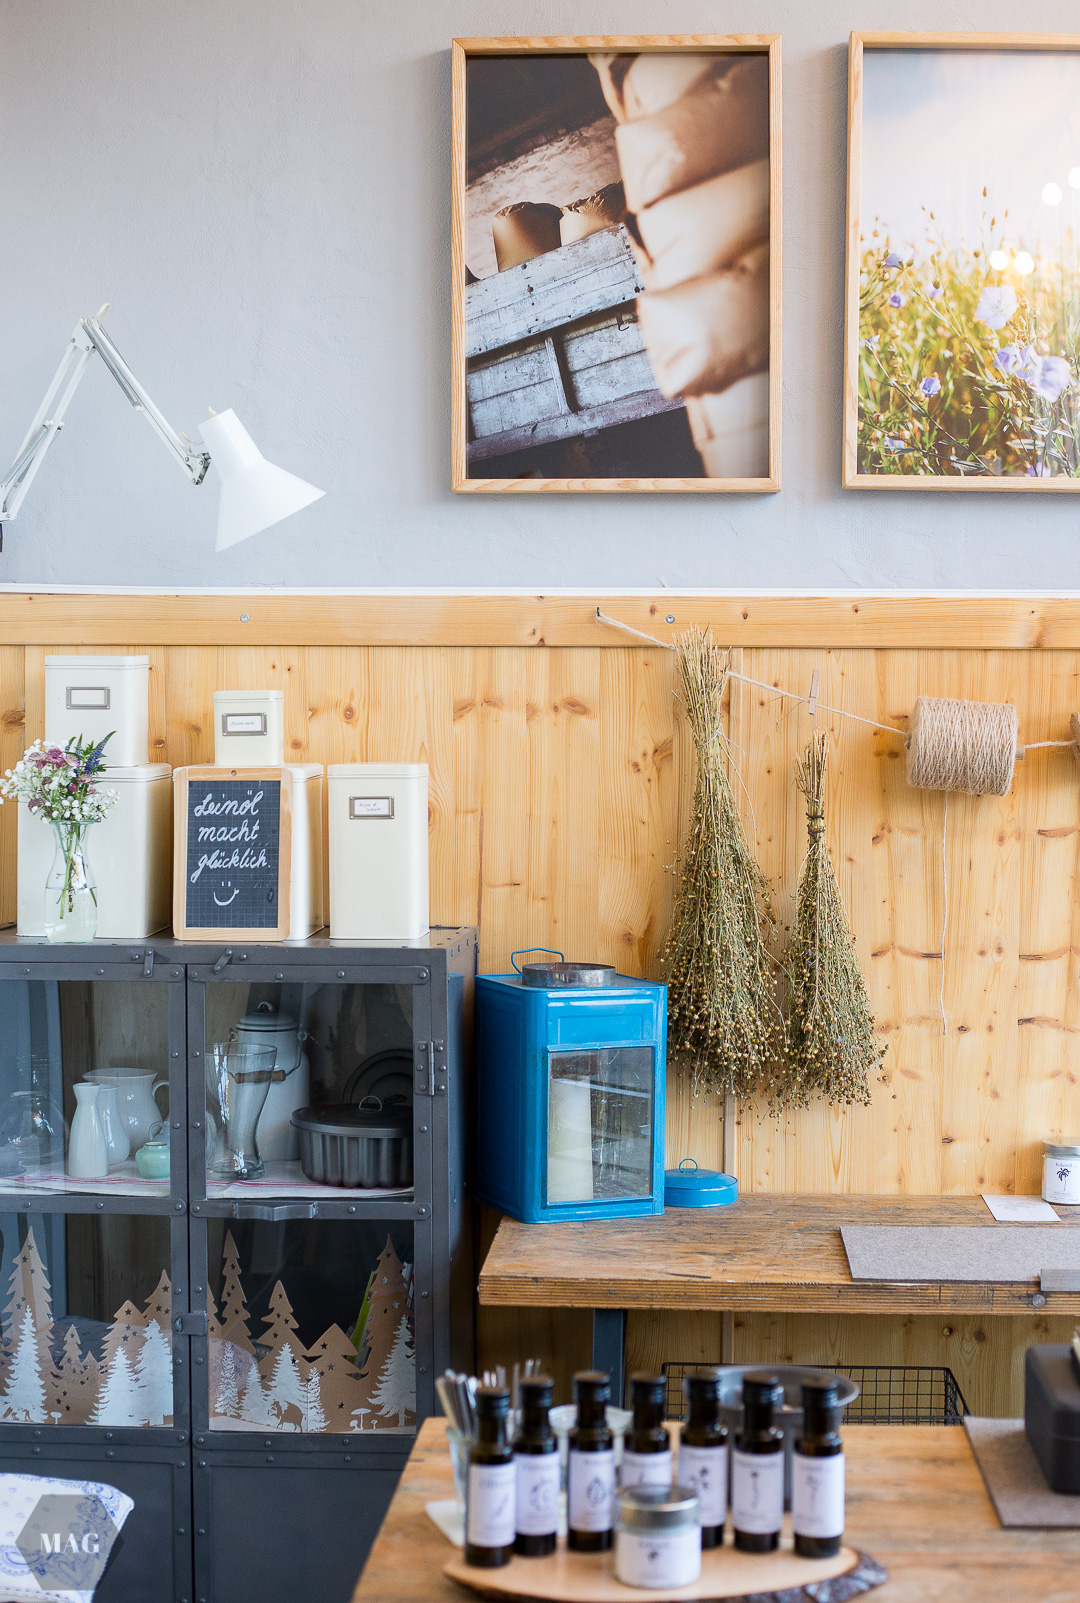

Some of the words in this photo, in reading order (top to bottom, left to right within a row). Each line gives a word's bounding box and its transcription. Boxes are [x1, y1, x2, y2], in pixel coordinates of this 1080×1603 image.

[194, 789, 264, 817] Leinöl
[197, 819, 260, 842] macht
[190, 848, 271, 884] glücklich.
